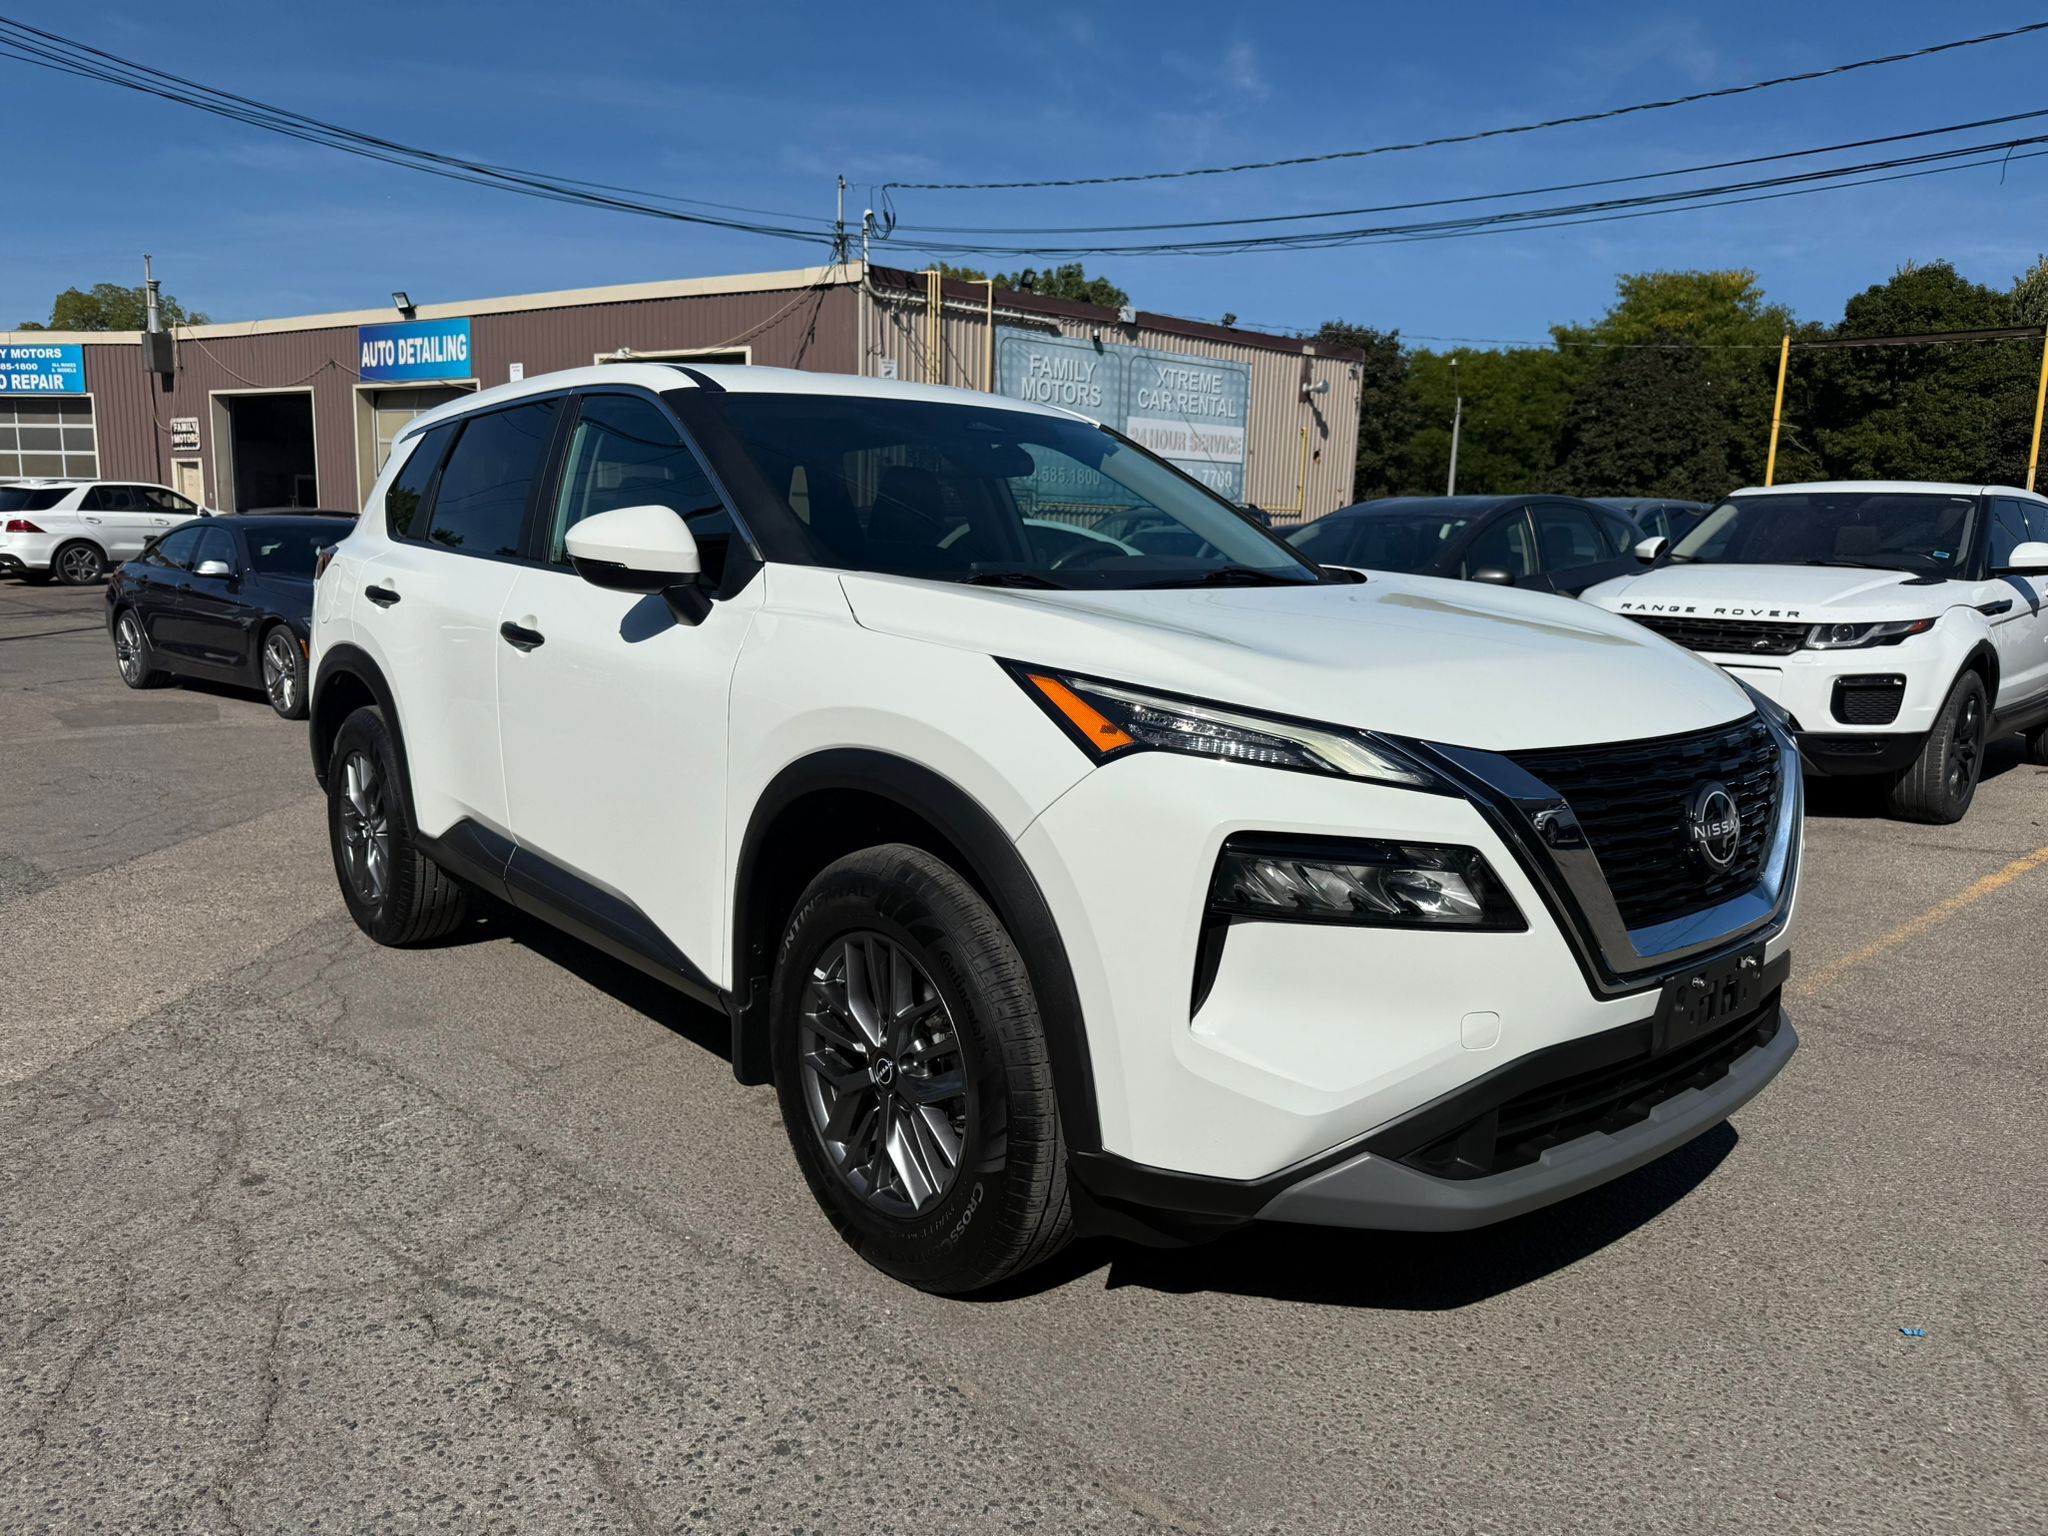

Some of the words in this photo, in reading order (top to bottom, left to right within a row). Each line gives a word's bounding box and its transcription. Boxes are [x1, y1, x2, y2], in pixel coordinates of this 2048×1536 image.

[10, 348, 62, 359] MOTORS
[361, 339, 395, 368] AUTO
[398, 333, 468, 366] DETAILING
[0, 362, 38, 371] 85-1800
[1029, 354, 1097, 384] FAMILY
[10, 373, 65, 390] REPAIR
[1021, 376, 1103, 408] MOTORS
[1156, 367, 1223, 395] XTREME
[1137, 387, 1174, 412] CAR
[1176, 392, 1238, 419] RENTAL
[1148, 428, 1187, 452] HOUR
[1188, 432, 1242, 456] SERVICE
[1620, 602, 1697, 613] RANGE
[1713, 607, 1801, 618] ROVER
[1694, 818, 1737, 839] NISSA
